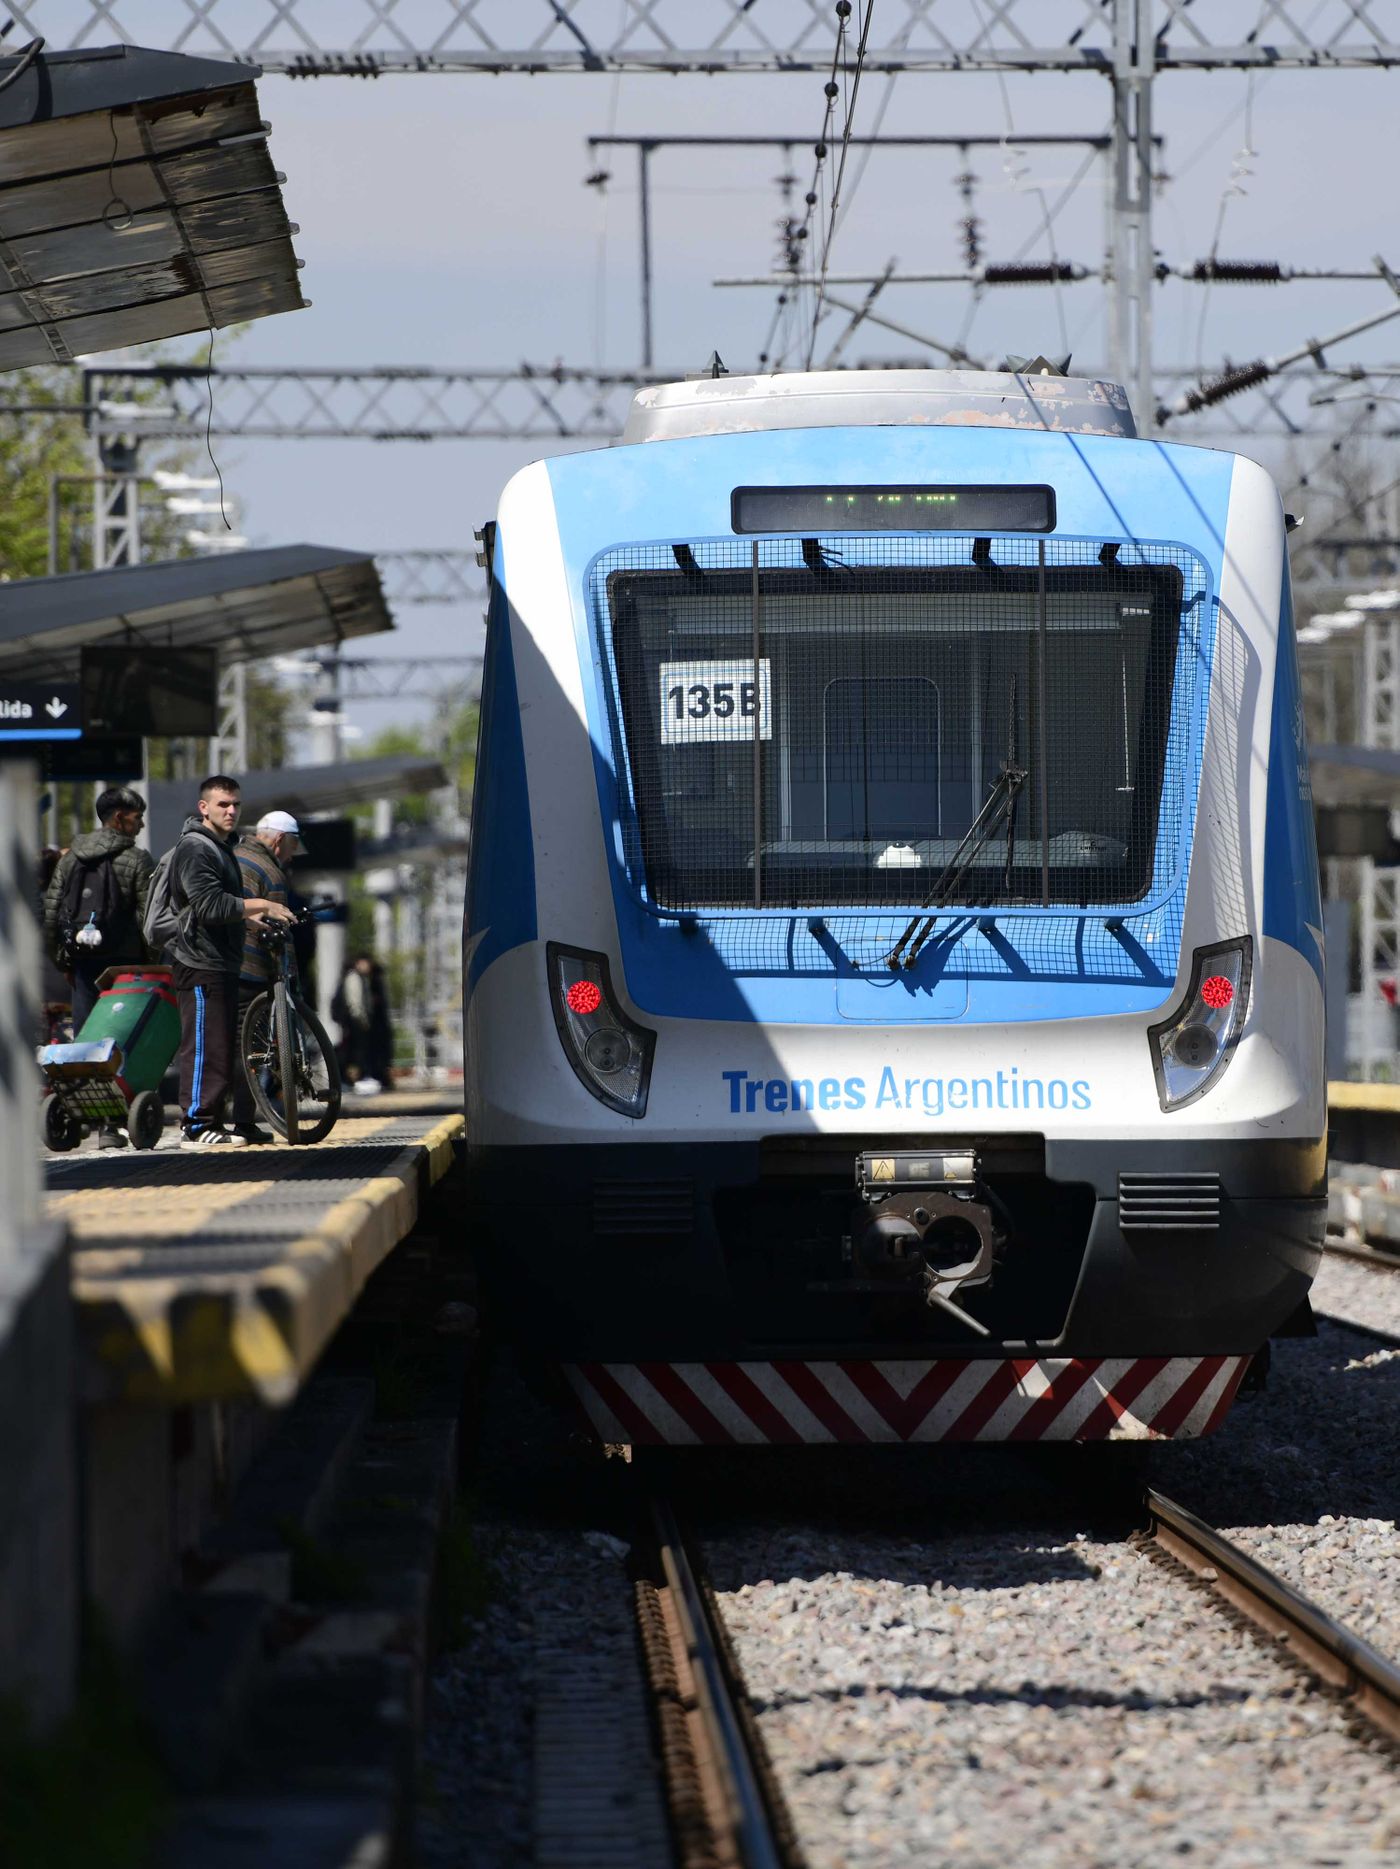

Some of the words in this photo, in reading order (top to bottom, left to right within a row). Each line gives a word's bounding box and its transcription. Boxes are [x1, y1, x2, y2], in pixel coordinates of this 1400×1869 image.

[669, 683, 761, 719] 135B
[722, 1070, 866, 1113] Trenes
[875, 1066, 1092, 1116] Argentinos
